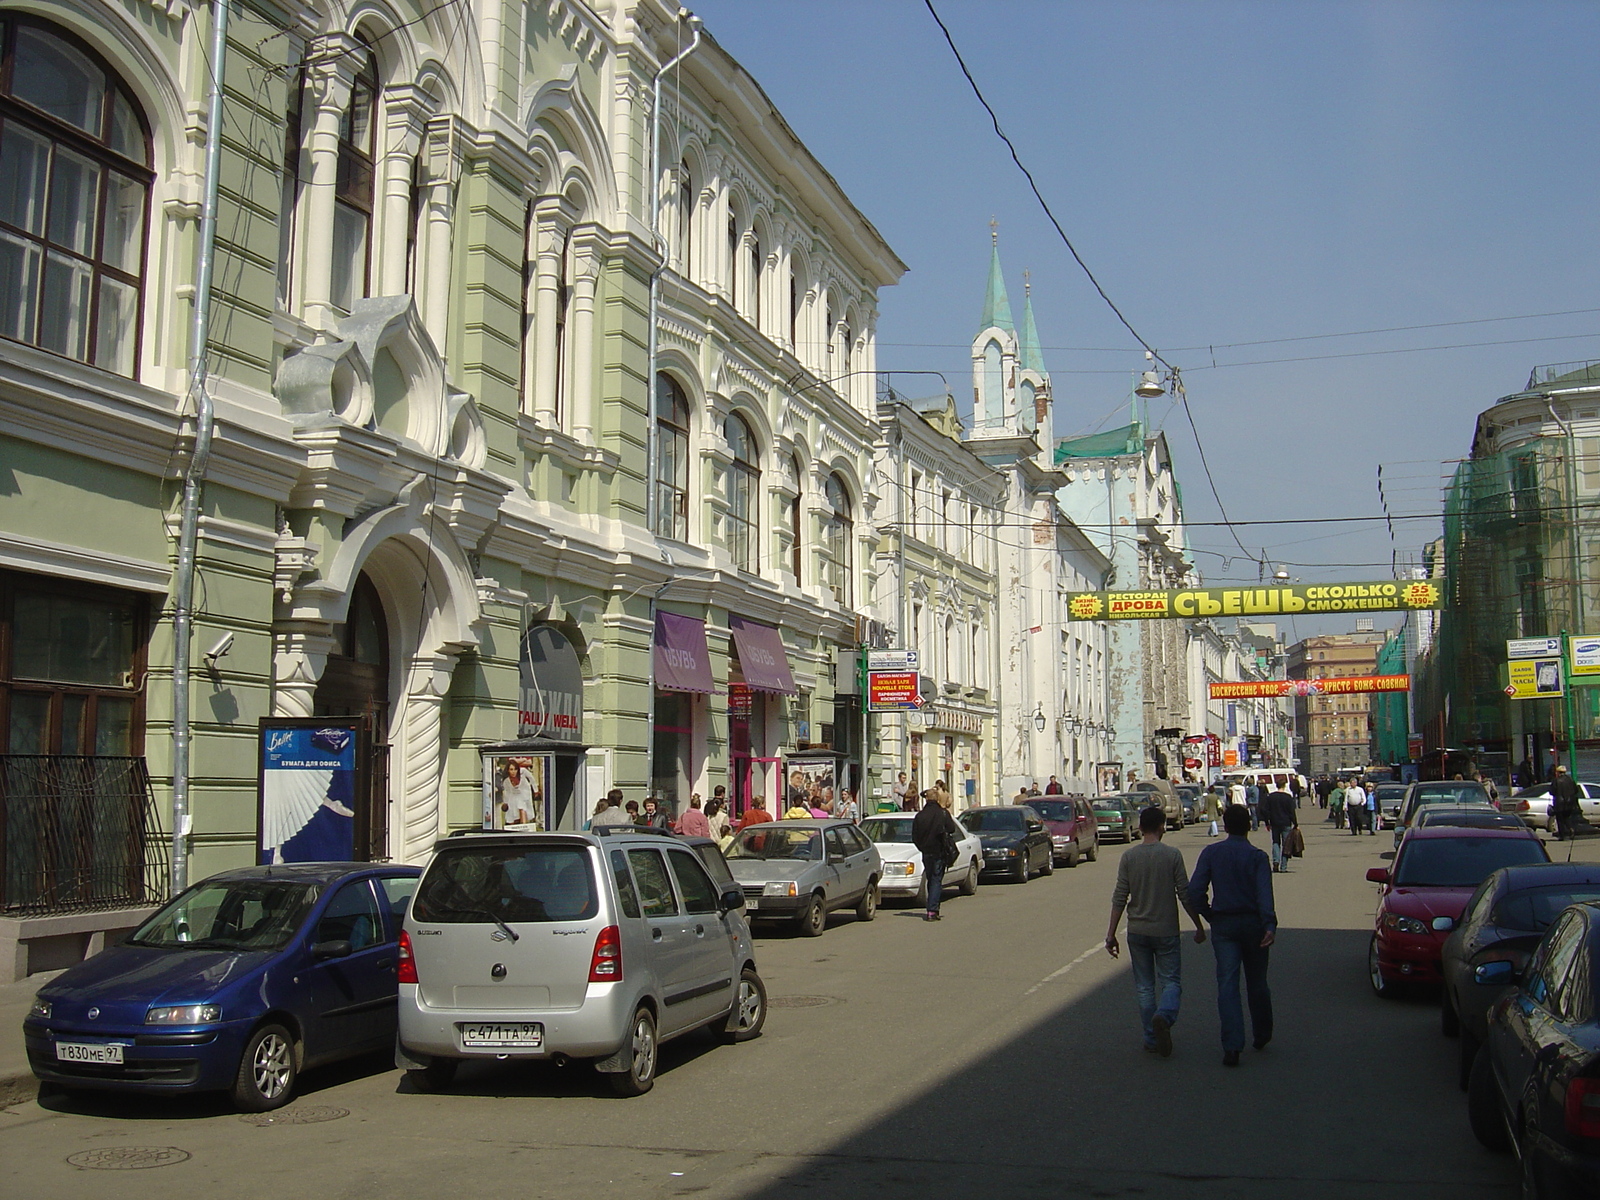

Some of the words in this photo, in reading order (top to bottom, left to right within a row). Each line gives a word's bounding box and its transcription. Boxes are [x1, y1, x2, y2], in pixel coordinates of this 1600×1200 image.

[1108, 592, 1168, 600] РЕСТОРАН
[1306, 583, 1397, 599] СКОЛЬКО
[1411, 585, 1429, 594] 55
[1112, 600, 1165, 612] ДРОВА
[1173, 588, 1306, 616] СЪЕШЬ
[1307, 597, 1398, 611] СМОЖЕШЬ!
[1413, 597, 1428, 605] 390
[664, 648, 696, 670] ОБУВЬ
[747, 646, 776, 667] ОБУВЬ
[1324, 681, 1351, 692] ХРИСТЕ
[518, 710, 549, 727] TALLY
[267, 730, 294, 752] Ballet
[305, 760, 318, 768] ДЛЯ
[468, 1025, 520, 1040] С471ТА
[522, 1024, 536, 1036] 97
[60, 1045, 104, 1061] Т830МЕ
[106, 1047, 118, 1058] 97
